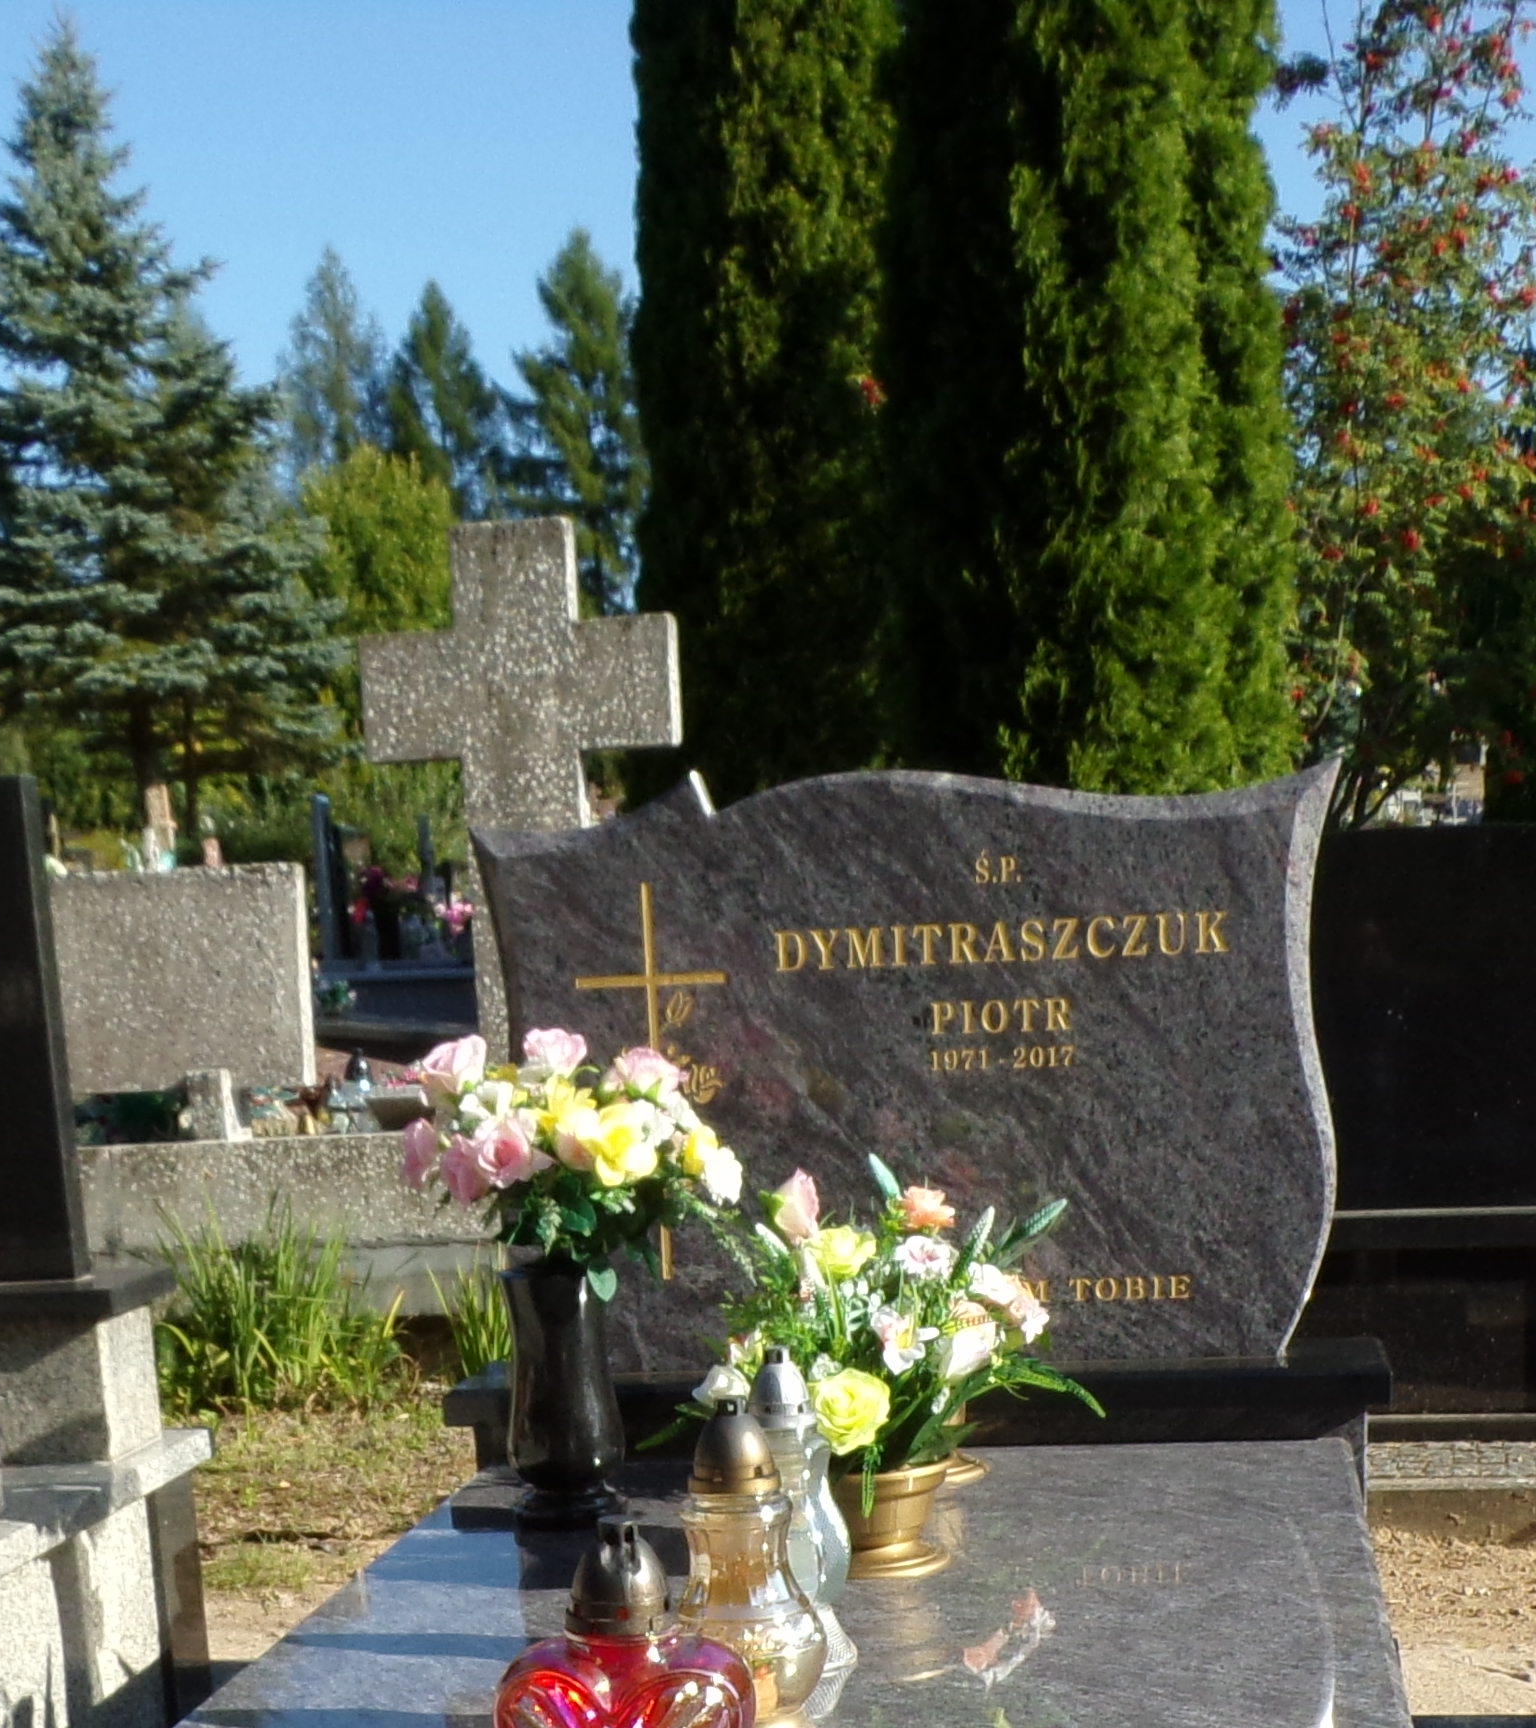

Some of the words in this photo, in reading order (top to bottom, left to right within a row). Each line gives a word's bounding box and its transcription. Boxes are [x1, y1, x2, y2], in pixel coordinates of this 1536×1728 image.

[975, 849, 1022, 884] Ś.P.
[774, 909, 1231, 972] DYMITRASZCZUK
[930, 997, 1072, 1035] PIOTR
[1069, 1274, 1193, 1303] TOBIE
